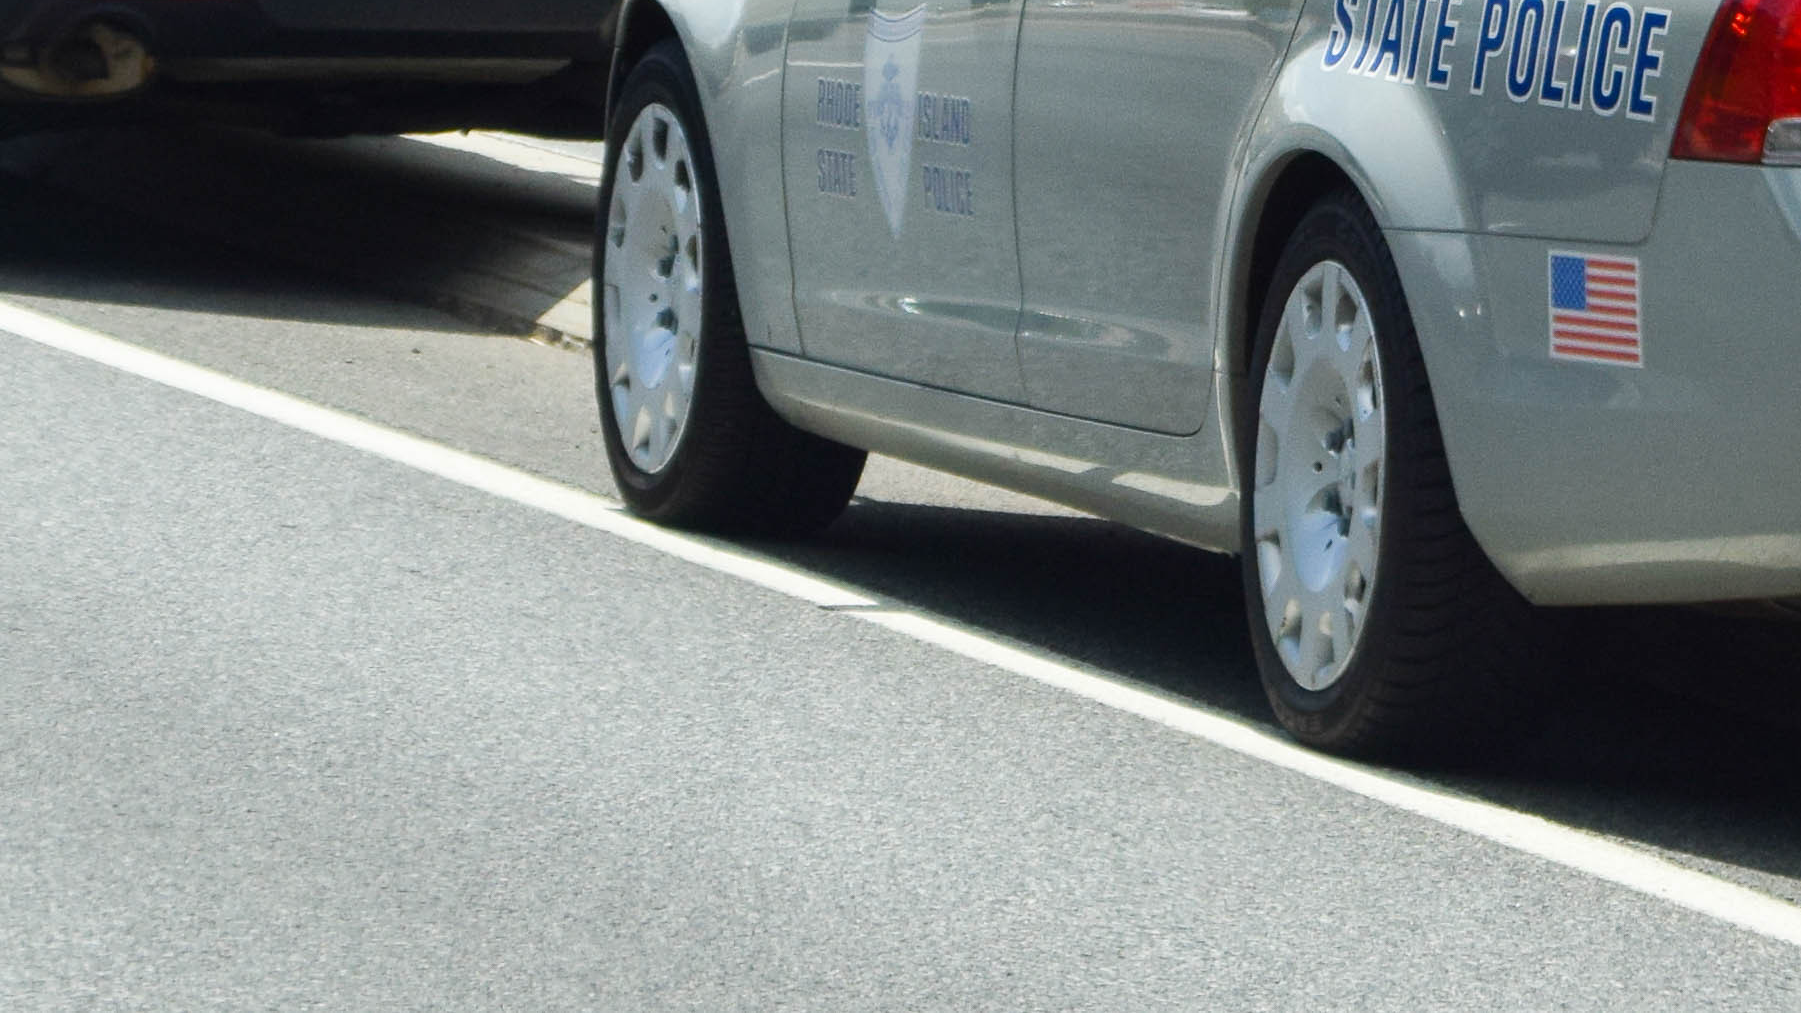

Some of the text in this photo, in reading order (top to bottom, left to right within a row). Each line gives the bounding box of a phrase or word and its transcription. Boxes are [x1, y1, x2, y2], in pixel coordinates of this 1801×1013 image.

[816, 76, 971, 147] RHODE ISLAND
[816, 148, 976, 219] STATE POLICE
